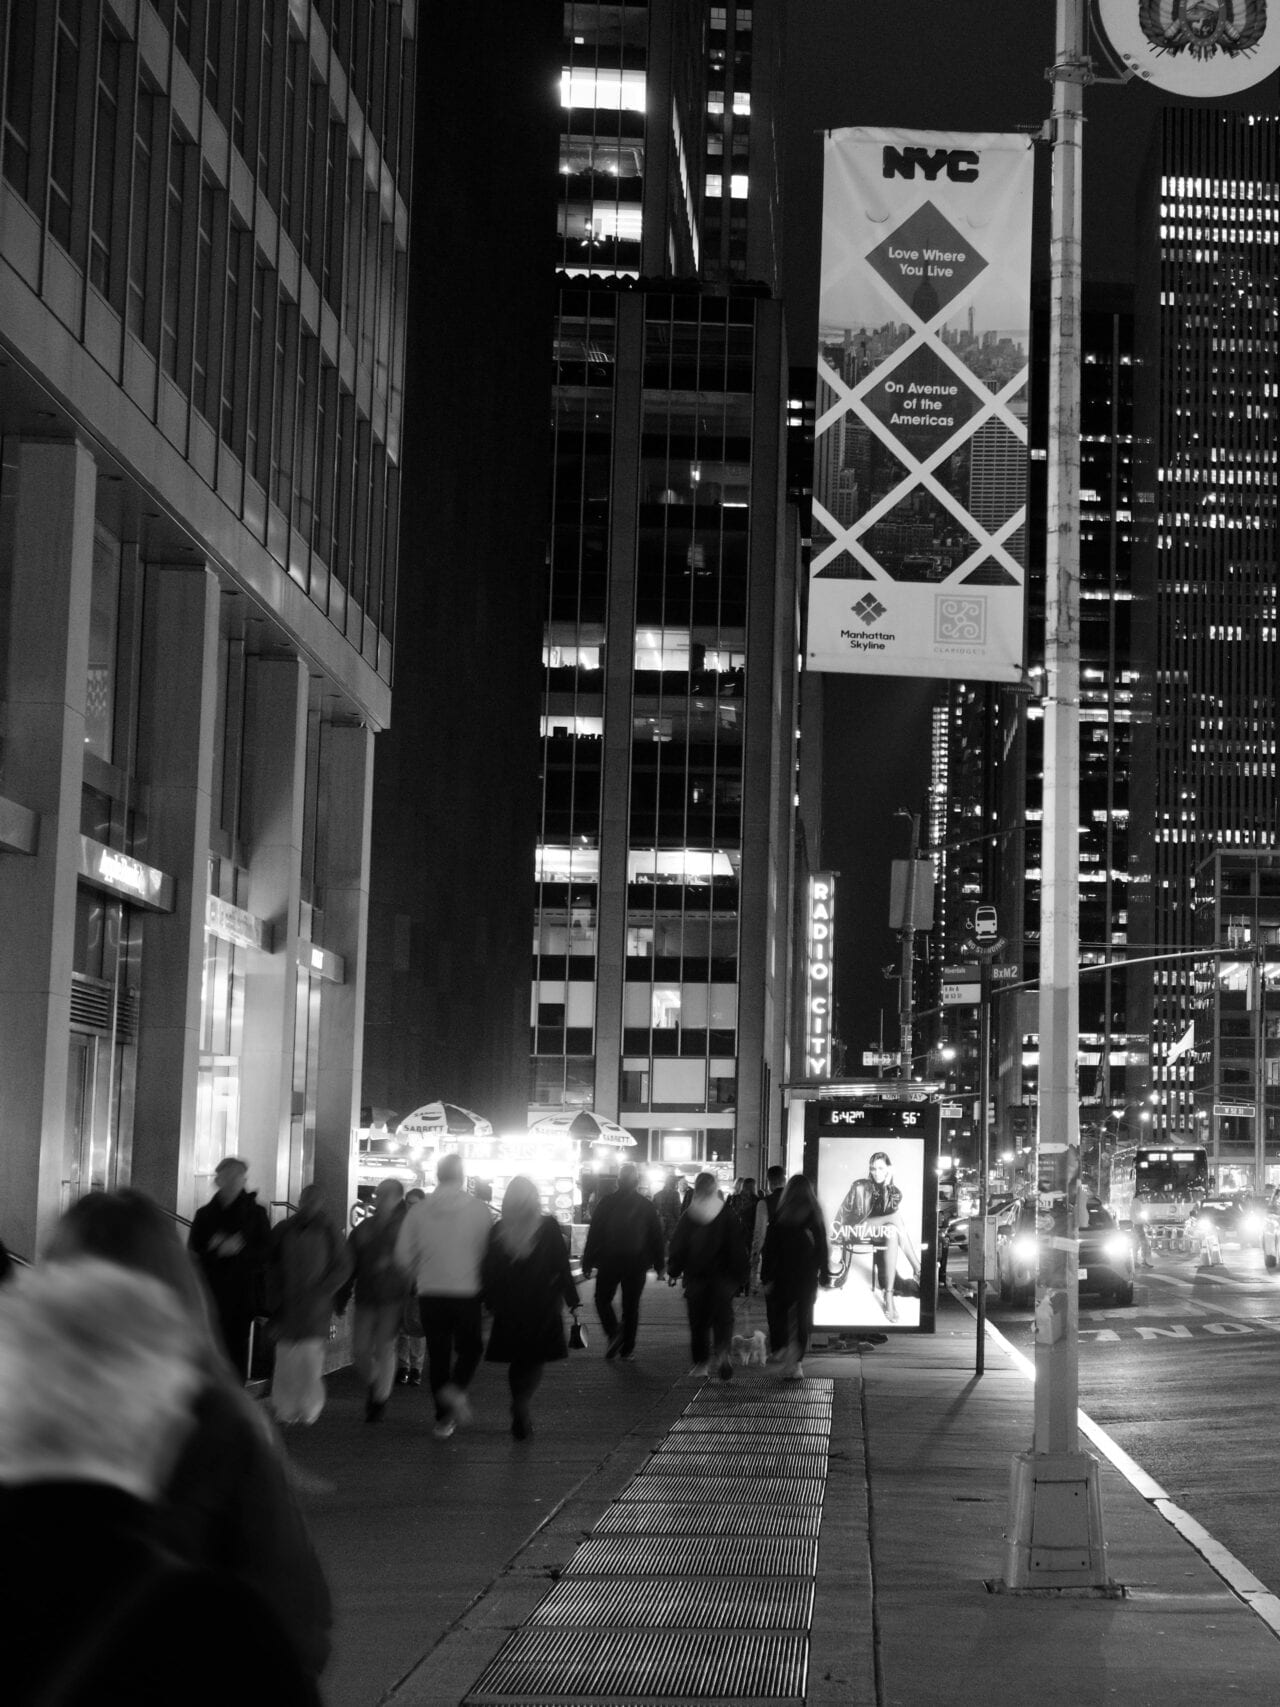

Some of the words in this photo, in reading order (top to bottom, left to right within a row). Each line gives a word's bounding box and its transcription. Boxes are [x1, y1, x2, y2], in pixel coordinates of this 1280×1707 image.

[883, 145, 980, 183] NYC
[888, 246, 919, 260] Love
[922, 249, 966, 262] Where
[899, 263, 923, 277] You
[927, 264, 954, 278] Live
[884, 381, 904, 394] On
[907, 383, 958, 395] Avenue
[903, 398, 918, 410] of
[920, 398, 942, 411] the
[890, 412, 954, 426] Americas
[840, 629, 895, 642] Manhattan
[850, 640, 886, 652] Skyline
[811, 883, 829, 980] RADIO
[993, 965, 1018, 978] BxM2
[810, 998, 827, 1075] CITY
[1077, 1321, 1255, 1344] ONL
